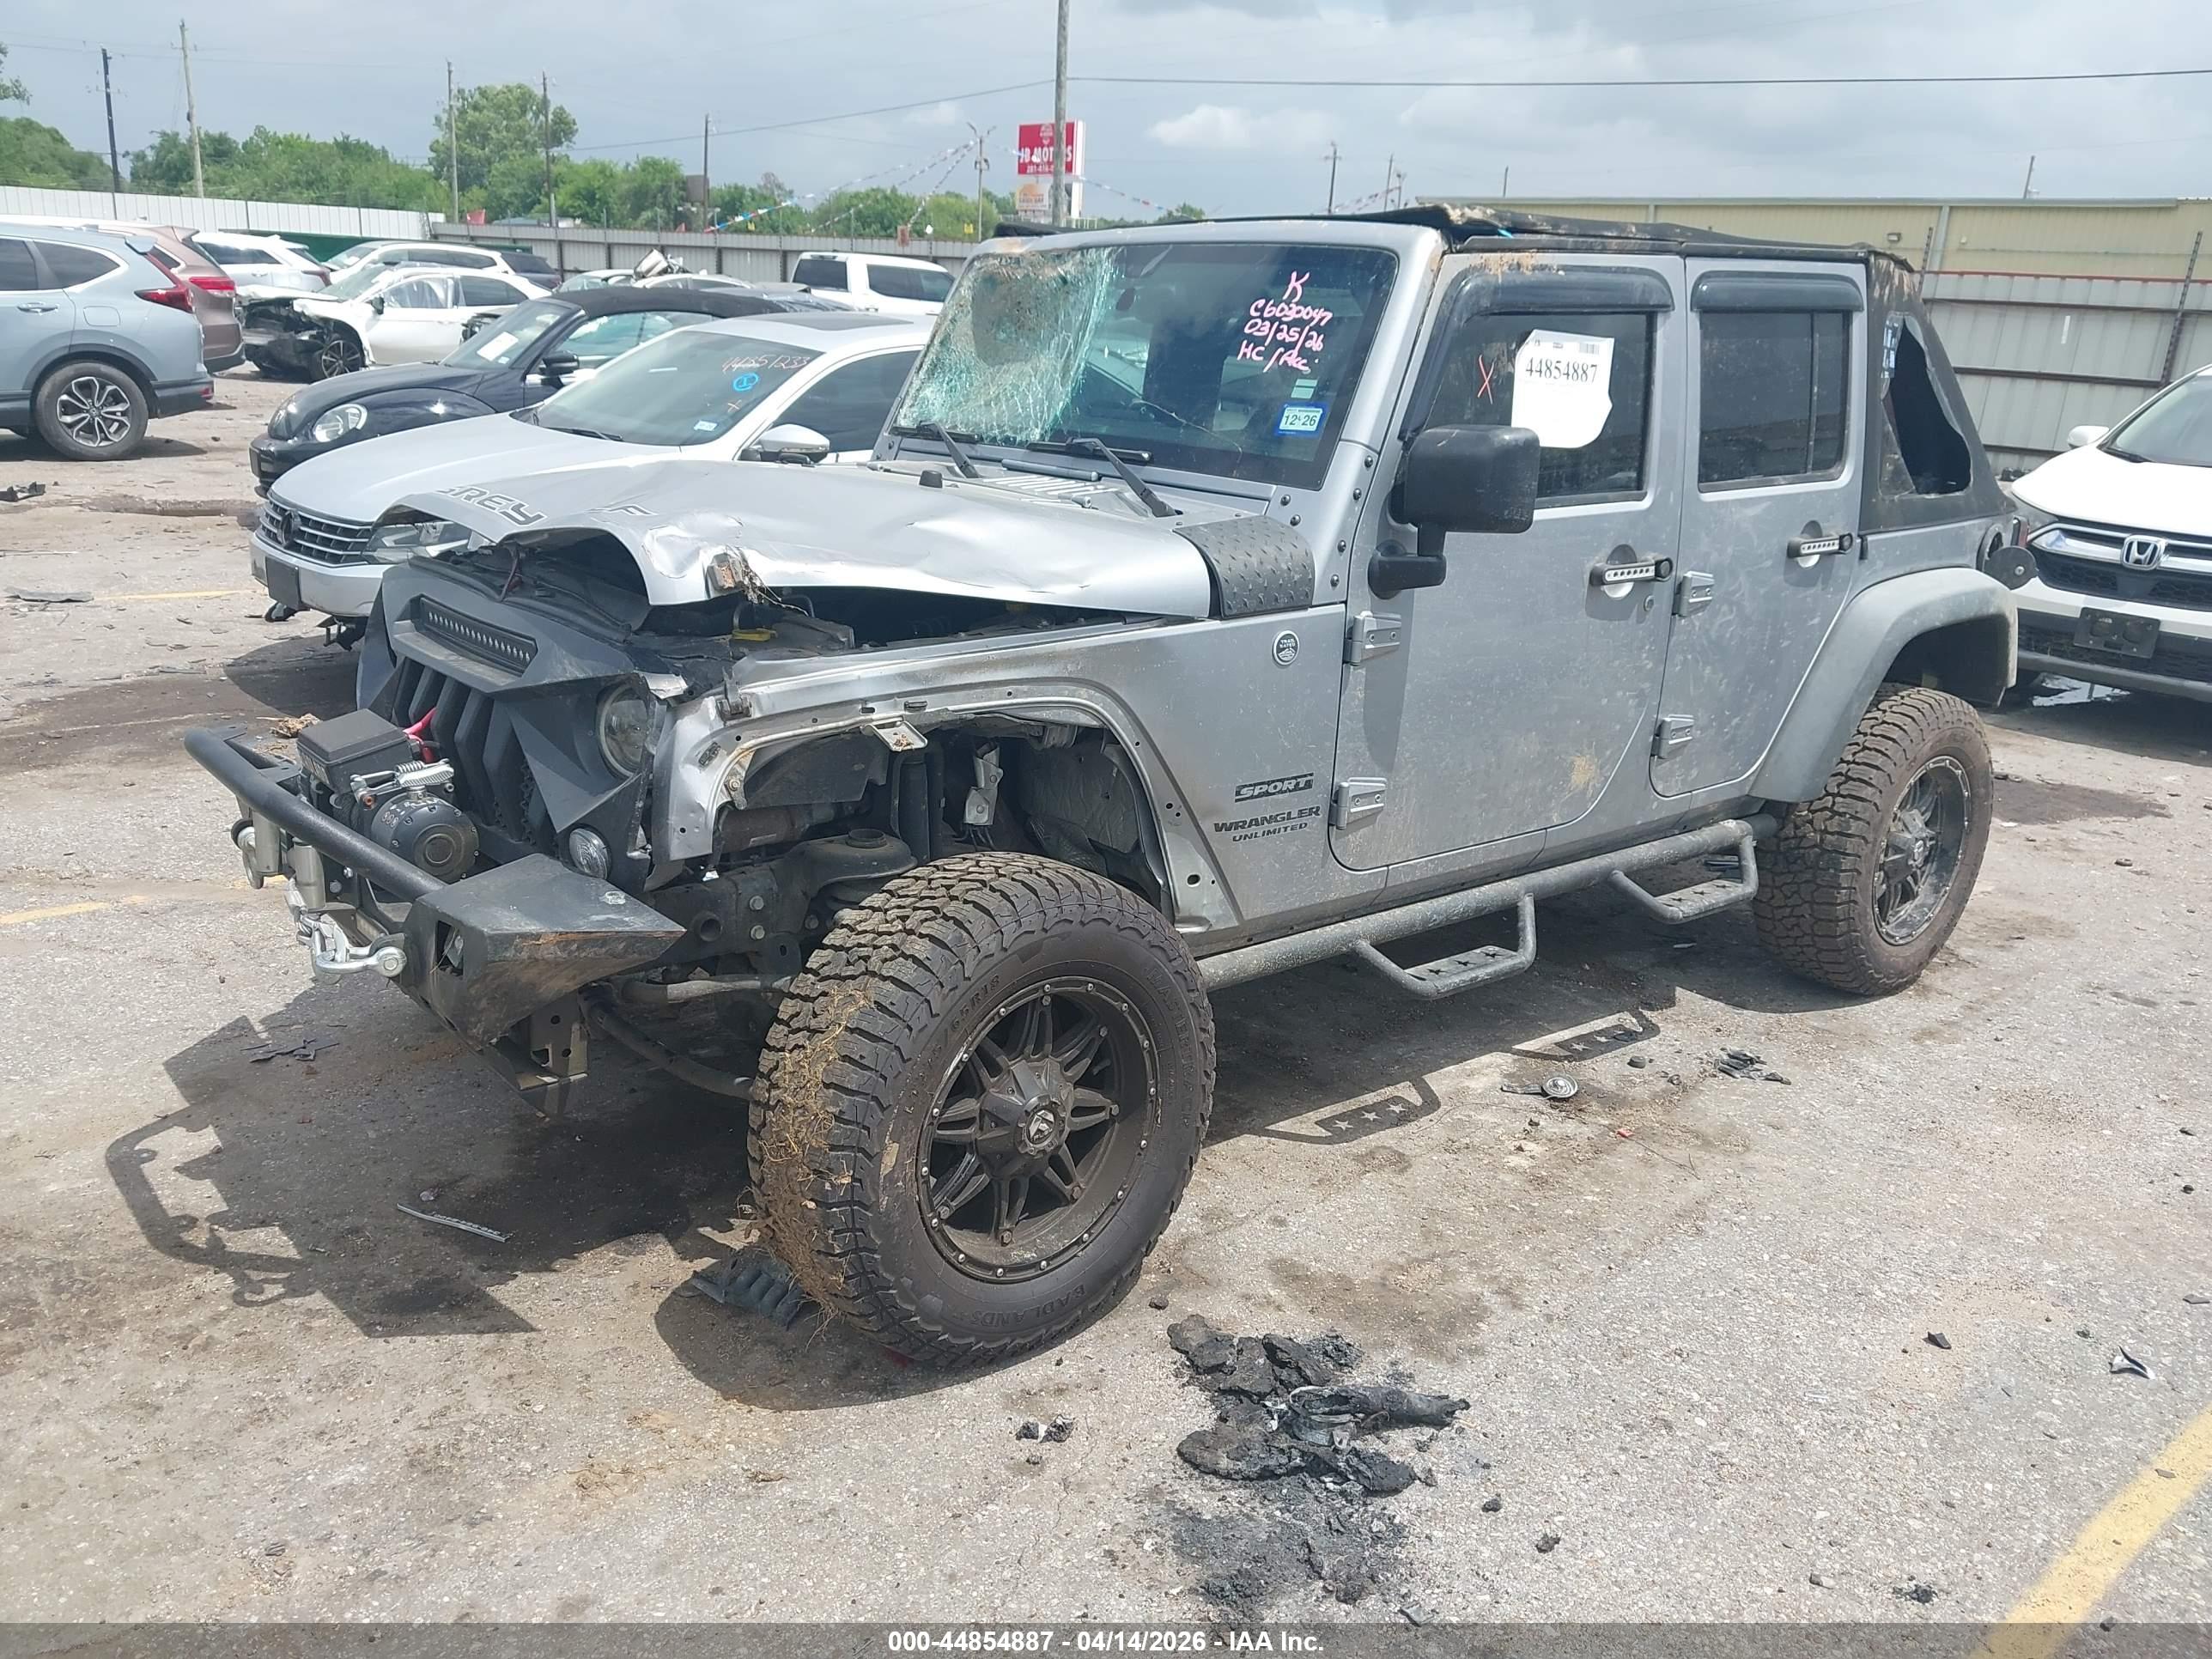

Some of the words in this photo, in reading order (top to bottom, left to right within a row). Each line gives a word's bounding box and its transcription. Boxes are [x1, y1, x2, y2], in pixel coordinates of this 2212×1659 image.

[1031, 144, 1073, 163] MOTS
[1282, 270, 1310, 303] K
[1243, 318, 1325, 359] 03/25/26
[1525, 356, 1598, 383] 44854887
[1284, 414, 1298, 426] 12
[1301, 414, 1318, 427] 26
[1238, 775, 1310, 799] SPORT
[1213, 805, 1322, 832] WRANGLER
[1232, 822, 1308, 842] UNLIMITED
